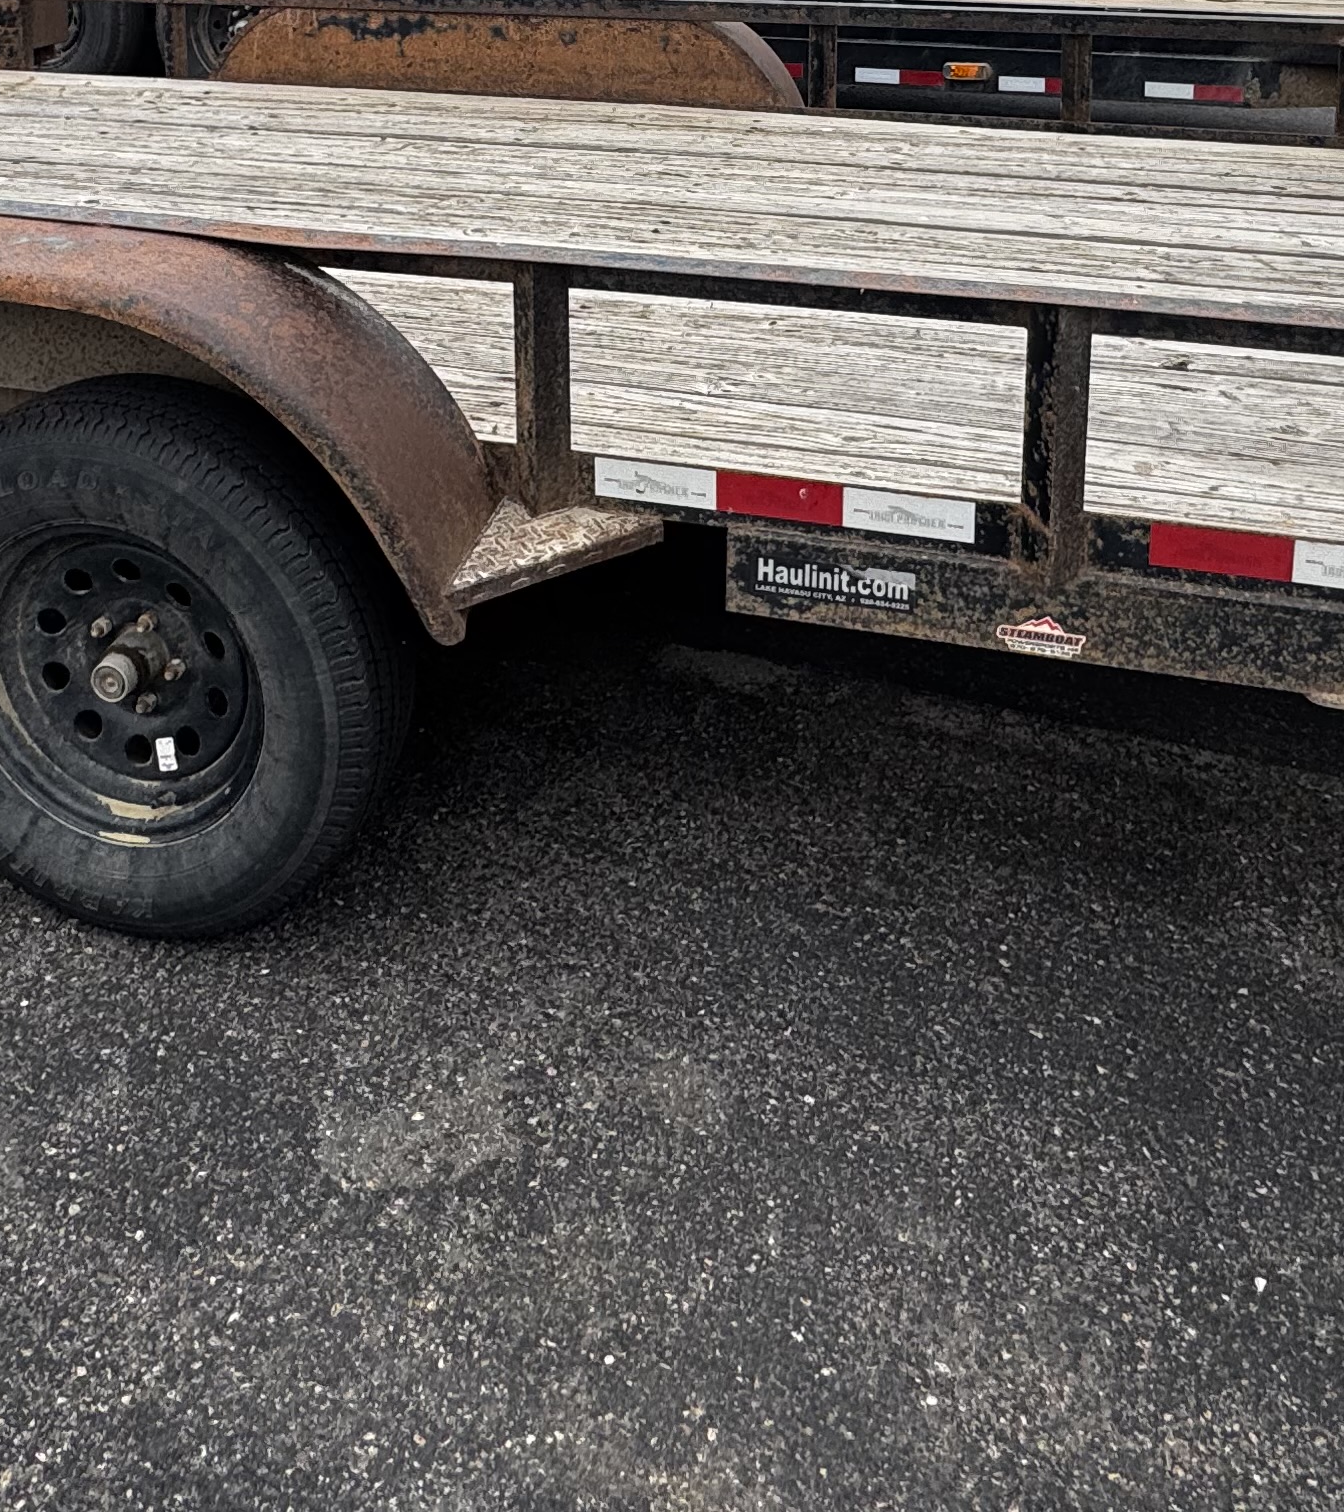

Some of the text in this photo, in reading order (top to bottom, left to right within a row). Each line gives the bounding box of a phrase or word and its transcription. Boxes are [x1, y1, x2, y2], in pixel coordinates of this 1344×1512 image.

[754, 584, 777, 594] LAKE
[757, 557, 910, 601] Haulinit.com
[998, 626, 1084, 647] STEAMBOAT
